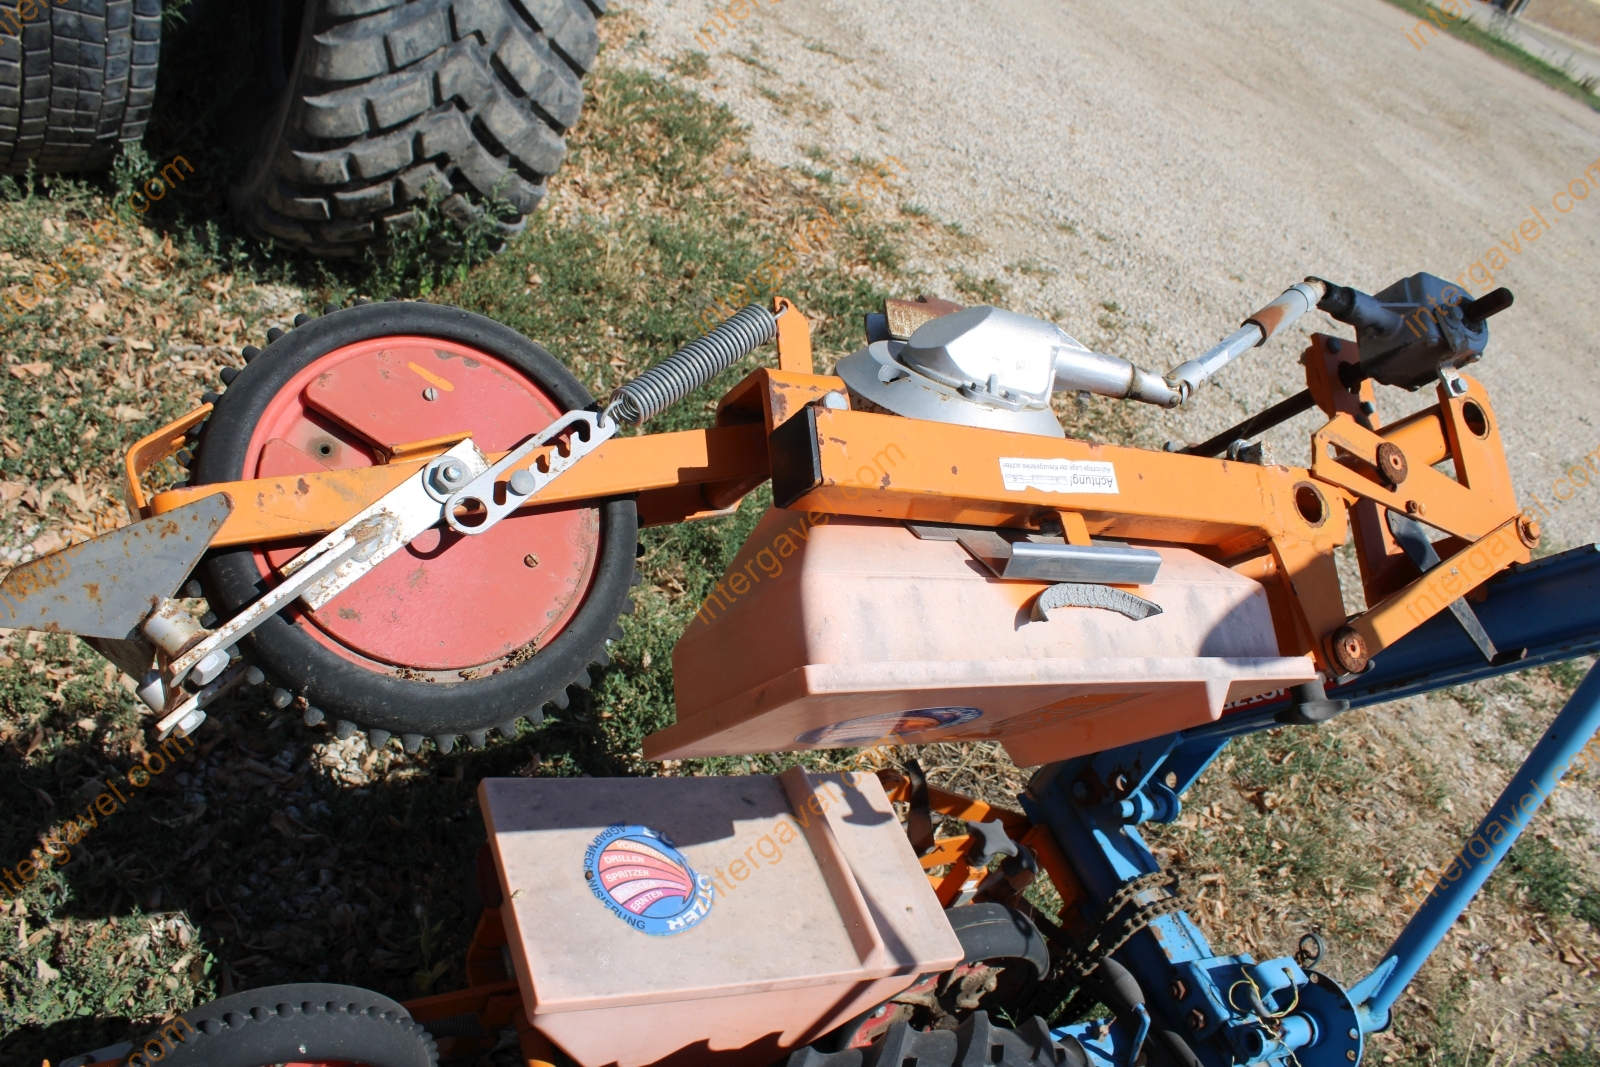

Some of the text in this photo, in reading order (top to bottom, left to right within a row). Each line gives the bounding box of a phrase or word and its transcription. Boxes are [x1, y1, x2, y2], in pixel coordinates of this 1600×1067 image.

[1002, 461, 1021, 469] achten
[1021, 462, 1059, 472] Kreuzgelenke
[1069, 464, 1083, 472] Lage
[1070, 474, 1113, 487] Achtung!
[603, 854, 645, 865] DRILLEN
[605, 869, 650, 883] SPRITZEN
[629, 890, 663, 911] ERNTEN
